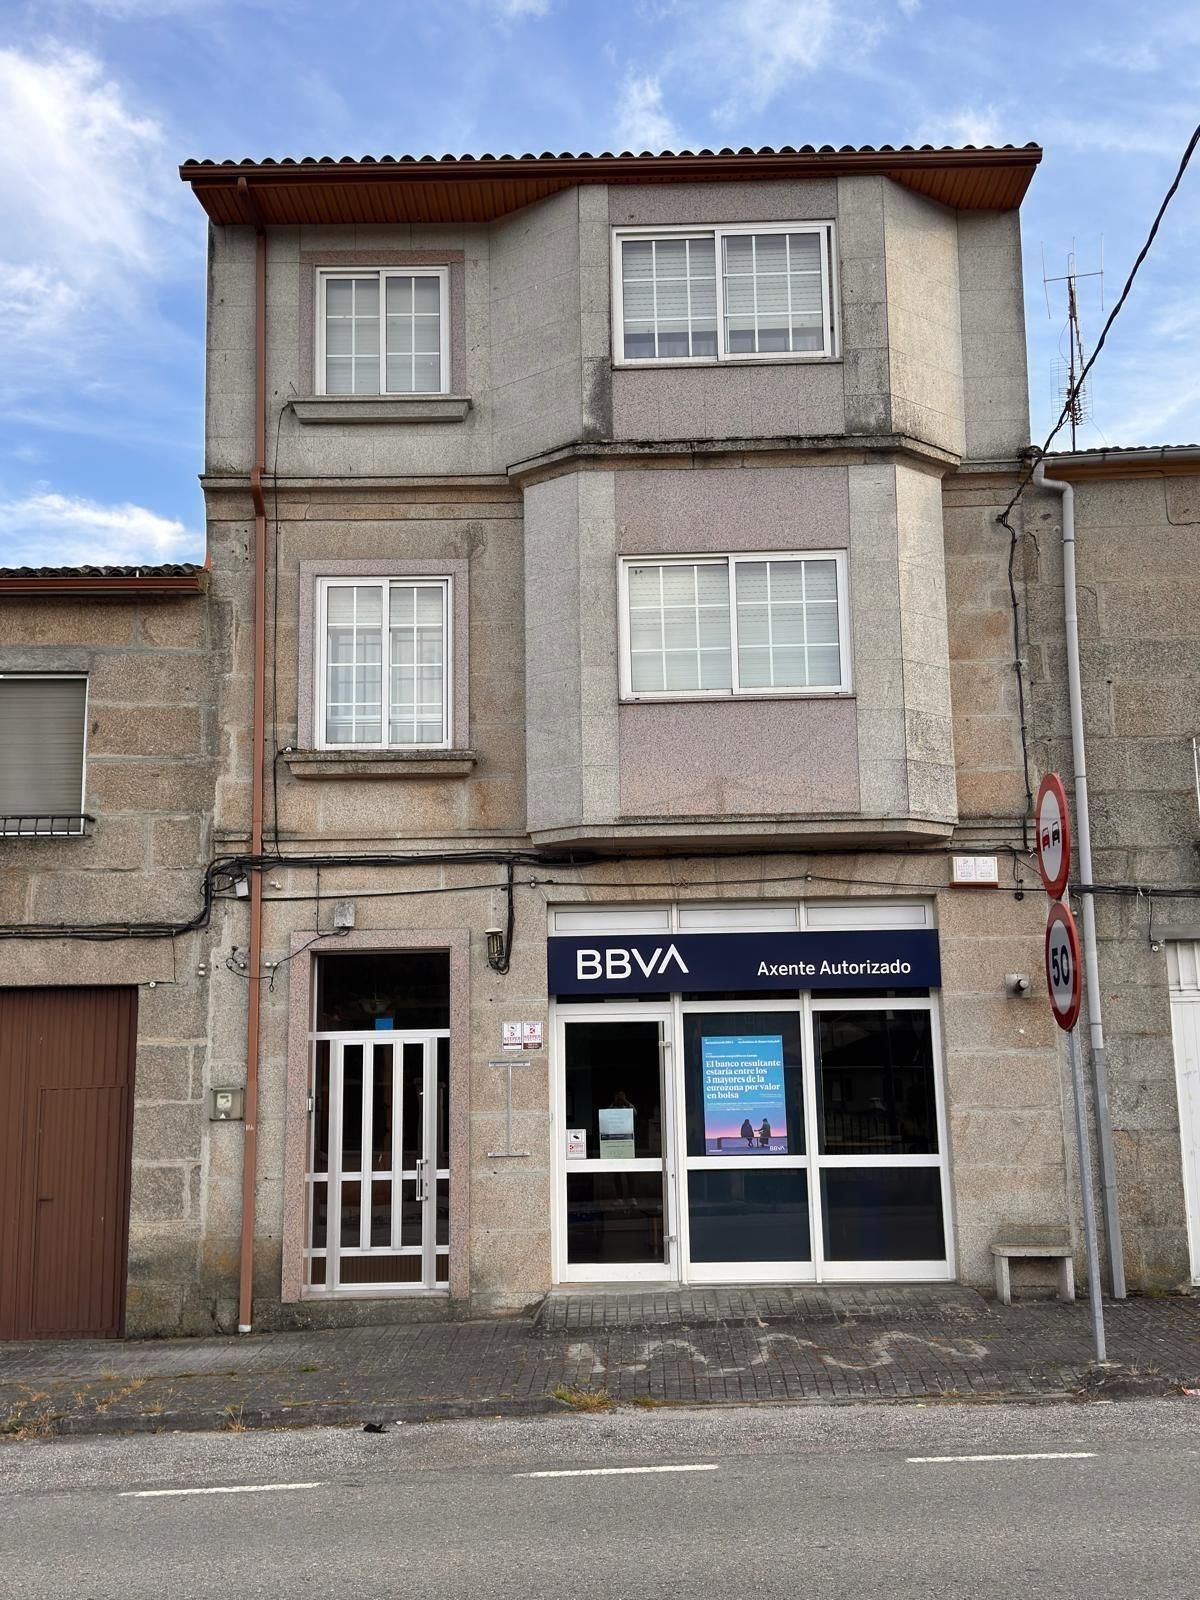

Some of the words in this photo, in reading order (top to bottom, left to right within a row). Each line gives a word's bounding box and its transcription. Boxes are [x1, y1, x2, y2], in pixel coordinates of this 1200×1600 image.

[576, 943, 690, 981] BBVA
[757, 960, 816, 977] Axente
[819, 958, 912, 976] Autorizado
[1051, 944, 1070, 987] 50
[712, 1076, 745, 1085] mayores
[746, 1075, 756, 1083] de
[717, 1091, 739, 1099] bolsa
